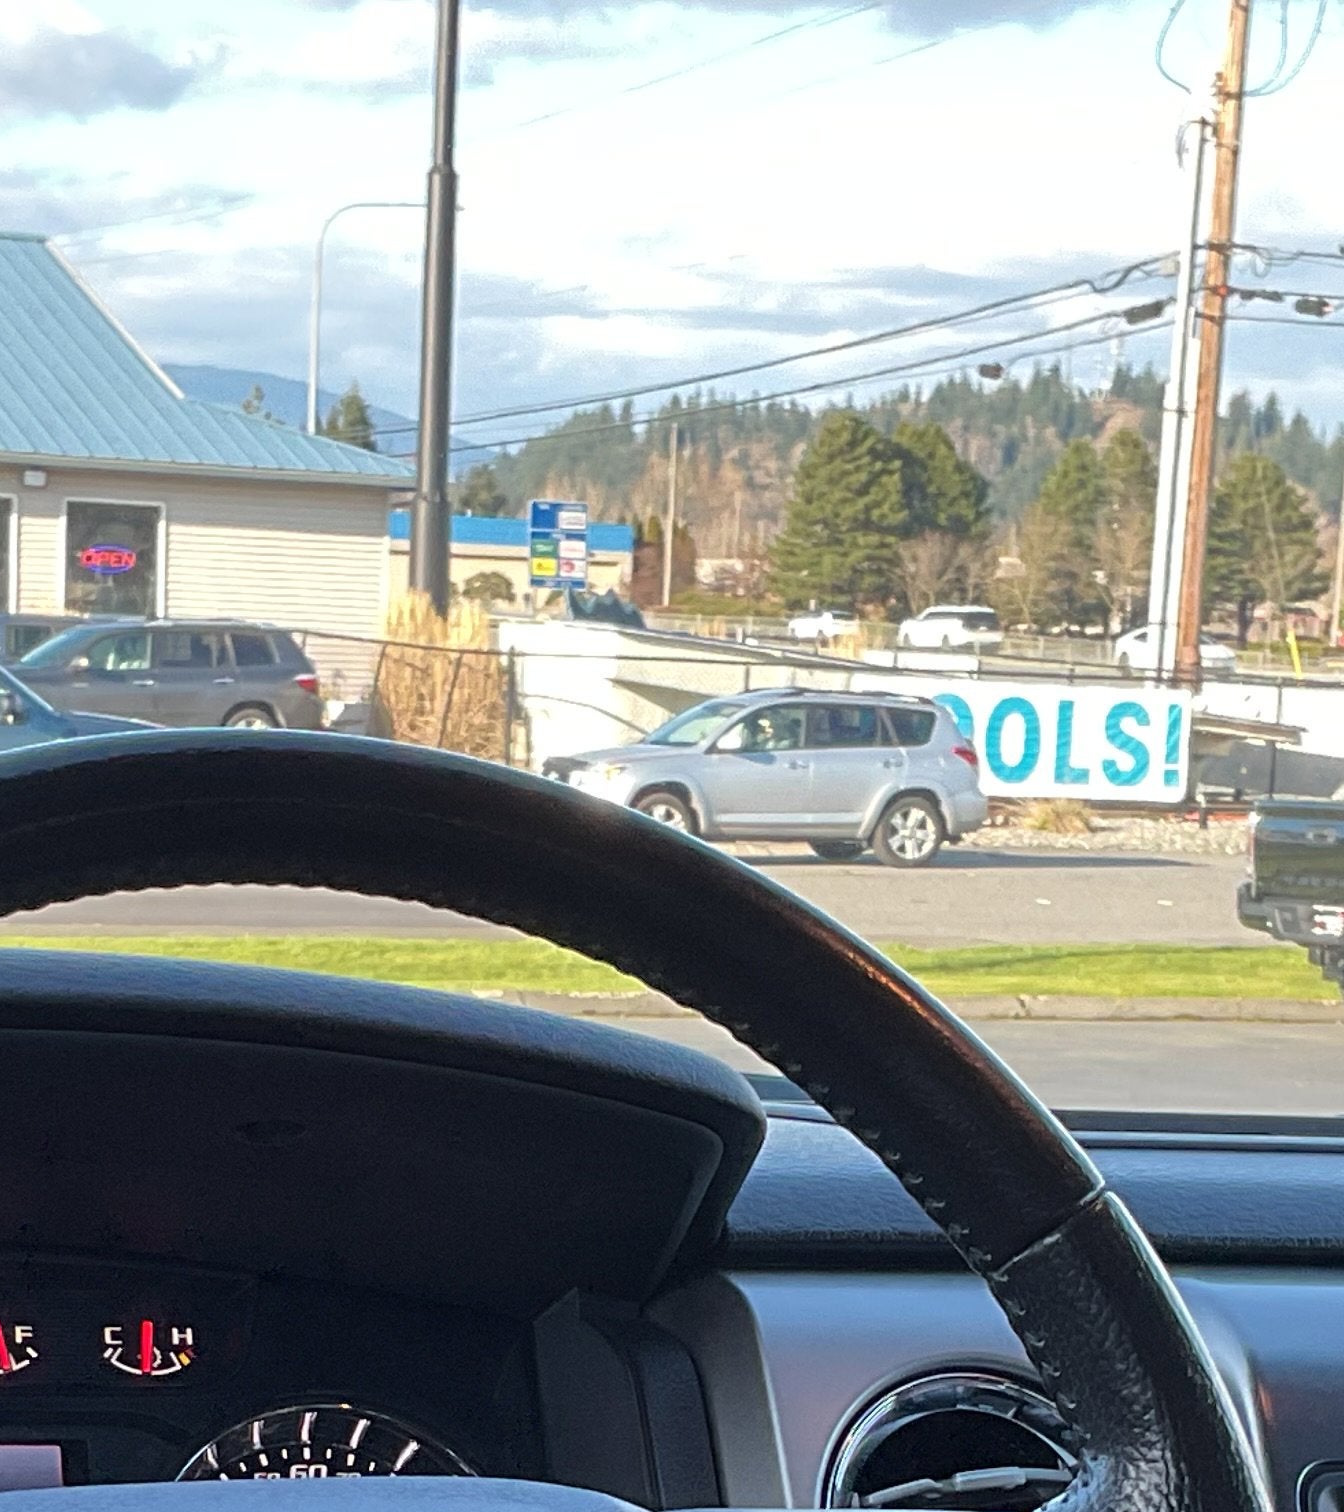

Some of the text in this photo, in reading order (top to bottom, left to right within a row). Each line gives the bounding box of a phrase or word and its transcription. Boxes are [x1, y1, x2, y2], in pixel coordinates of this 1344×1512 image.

[80, 547, 137, 570] OPEN
[14, 1325, 34, 1344] F
[104, 1327, 123, 1345] C
[172, 1328, 193, 1346] H
